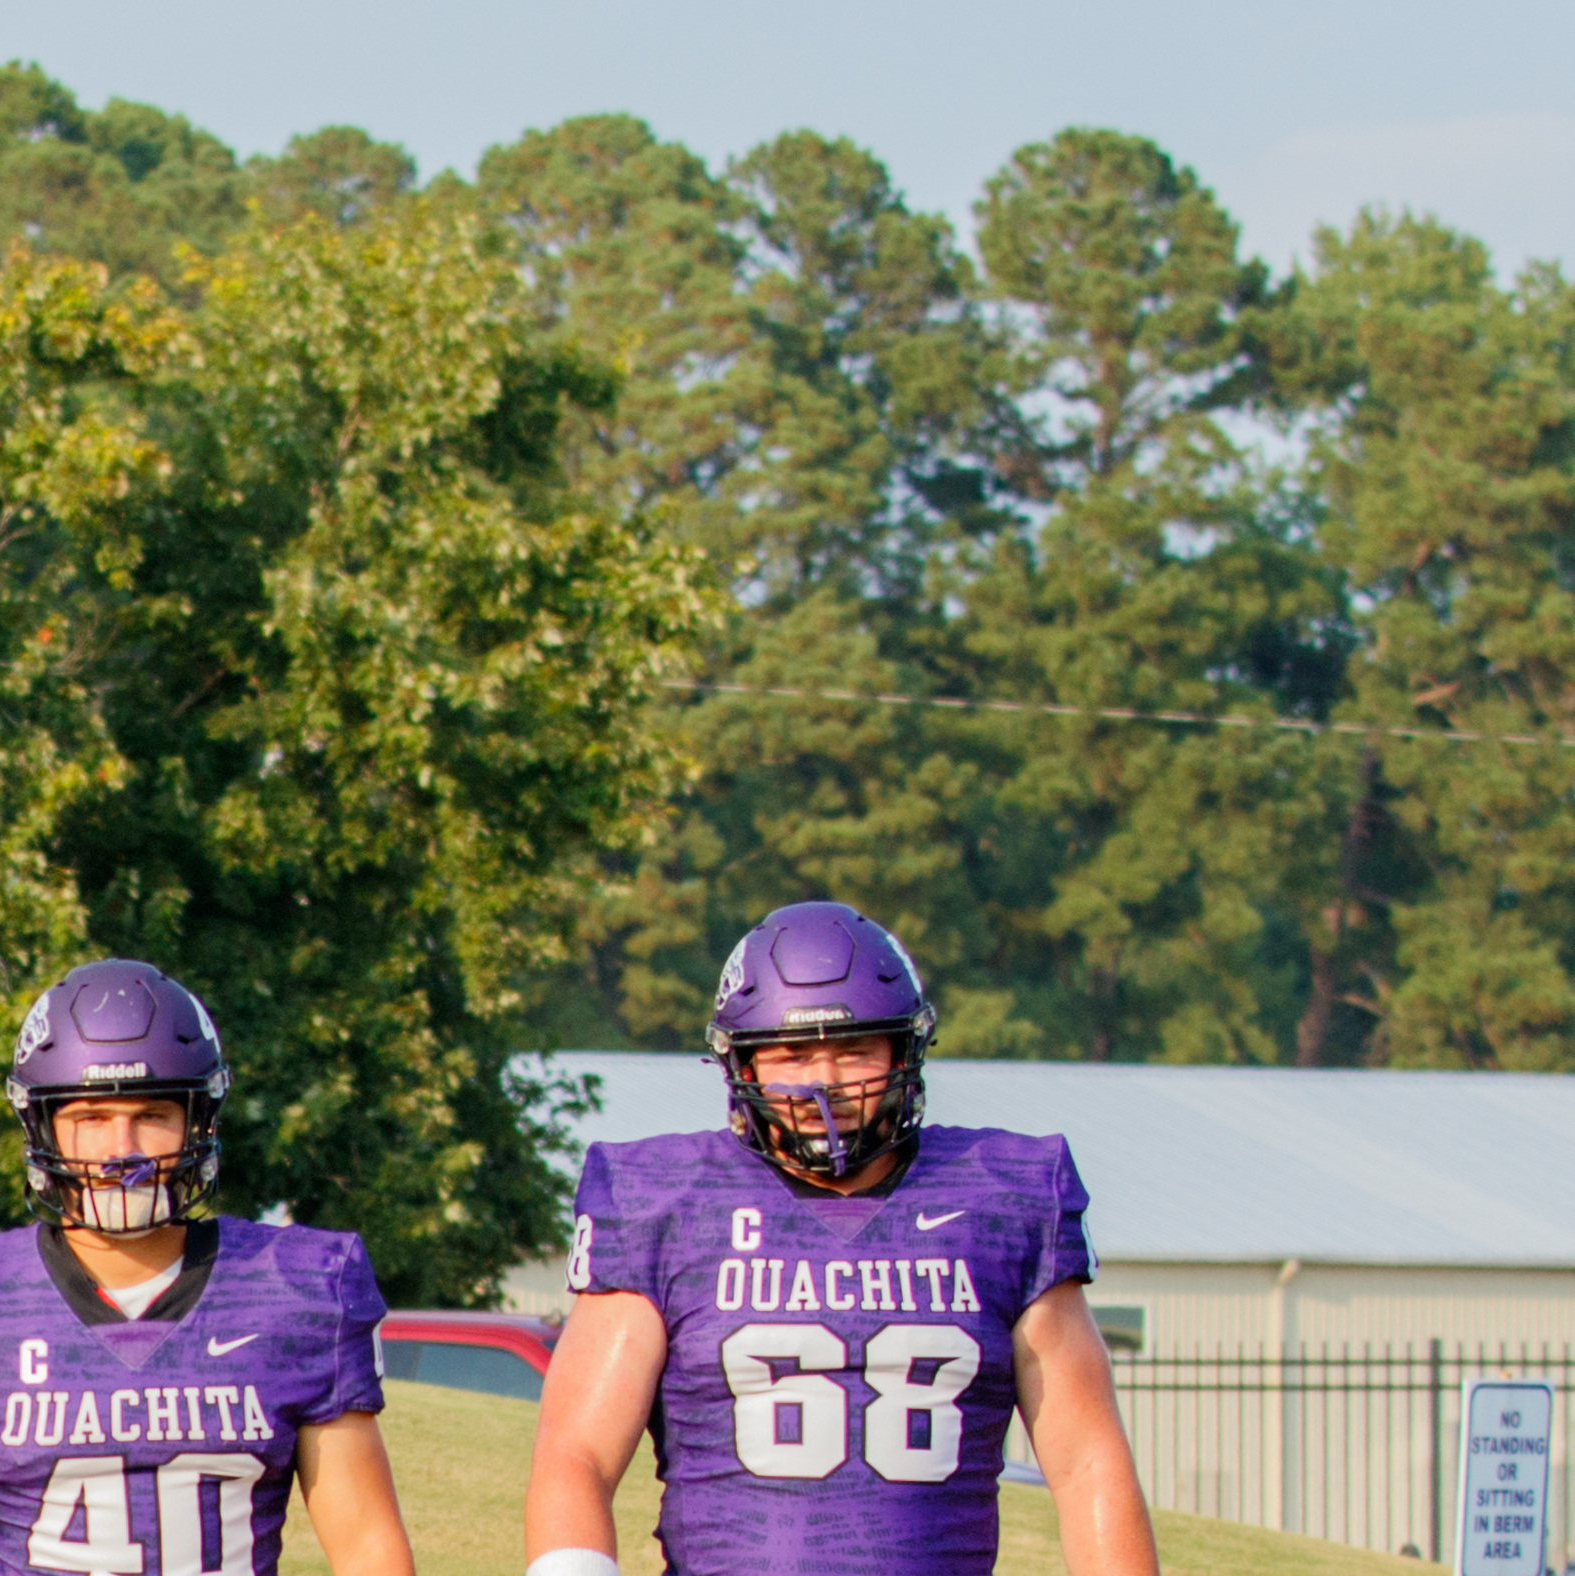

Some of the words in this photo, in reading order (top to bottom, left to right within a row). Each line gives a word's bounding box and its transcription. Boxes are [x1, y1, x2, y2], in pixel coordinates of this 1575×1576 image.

[87, 1061, 147, 1080] Riddell
[731, 1208, 762, 1252] C
[715, 1258, 981, 1313] OUACHITA
[19, 1338, 48, 1384] C
[721, 1323, 982, 1483] 68
[0, 1384, 275, 1447] OUACHITA
[1500, 1411, 1521, 1429] NO
[1471, 1436, 1545, 1455] STANDING
[1497, 1463, 1518, 1481] OR
[1476, 1489, 1535, 1507] SITTING
[1474, 1515, 1489, 1533] IN
[1494, 1515, 1534, 1533] BERM
[1483, 1541, 1522, 1560] AREA
